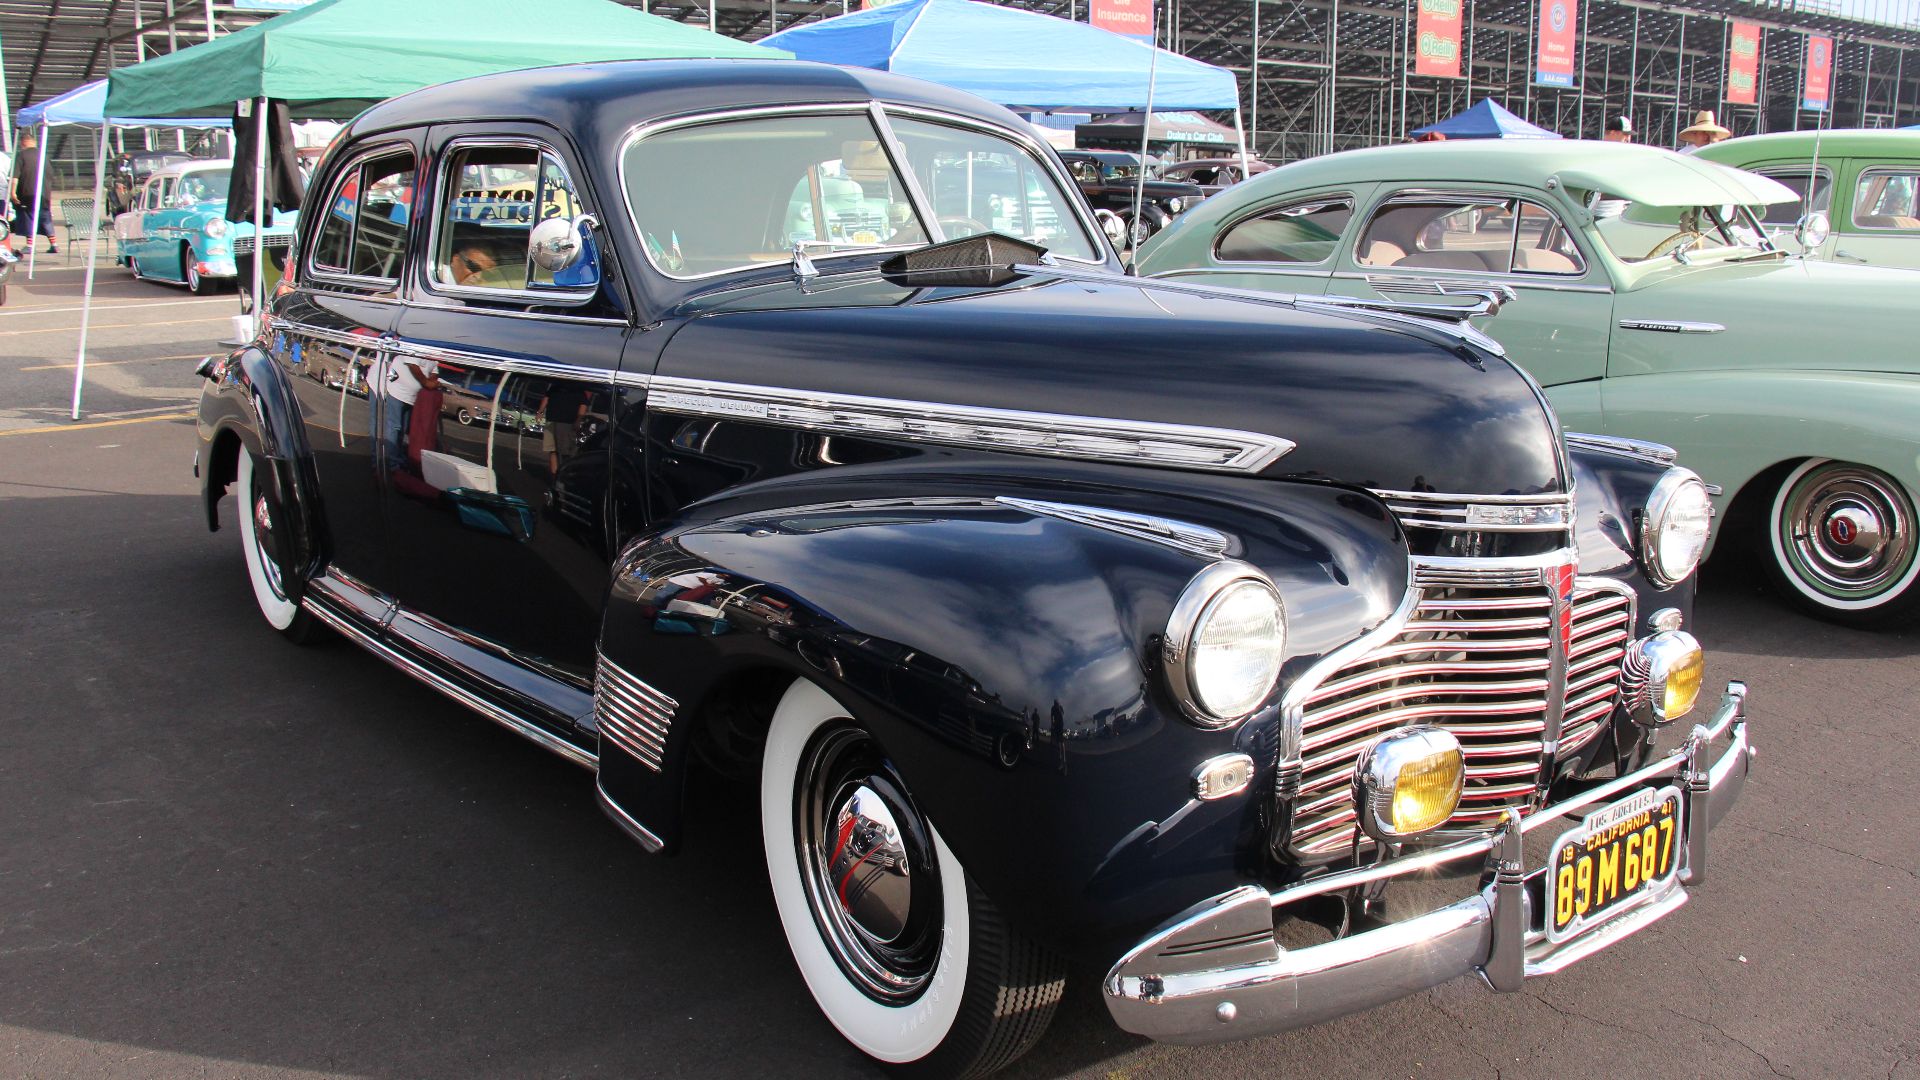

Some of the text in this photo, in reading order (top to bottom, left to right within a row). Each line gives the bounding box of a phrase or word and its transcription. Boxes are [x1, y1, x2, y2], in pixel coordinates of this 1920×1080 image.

[1097, 8, 1147, 23] Insurance
[1166, 130, 1224, 142] Duke's Car Club
[671, 394, 764, 414] SPECIAL DELUXE
[1590, 795, 1651, 831] LOS ANGELES
[1562, 800, 1673, 863] 19 CALIFORNIA 41
[1557, 816, 1675, 926] 89 M 687
